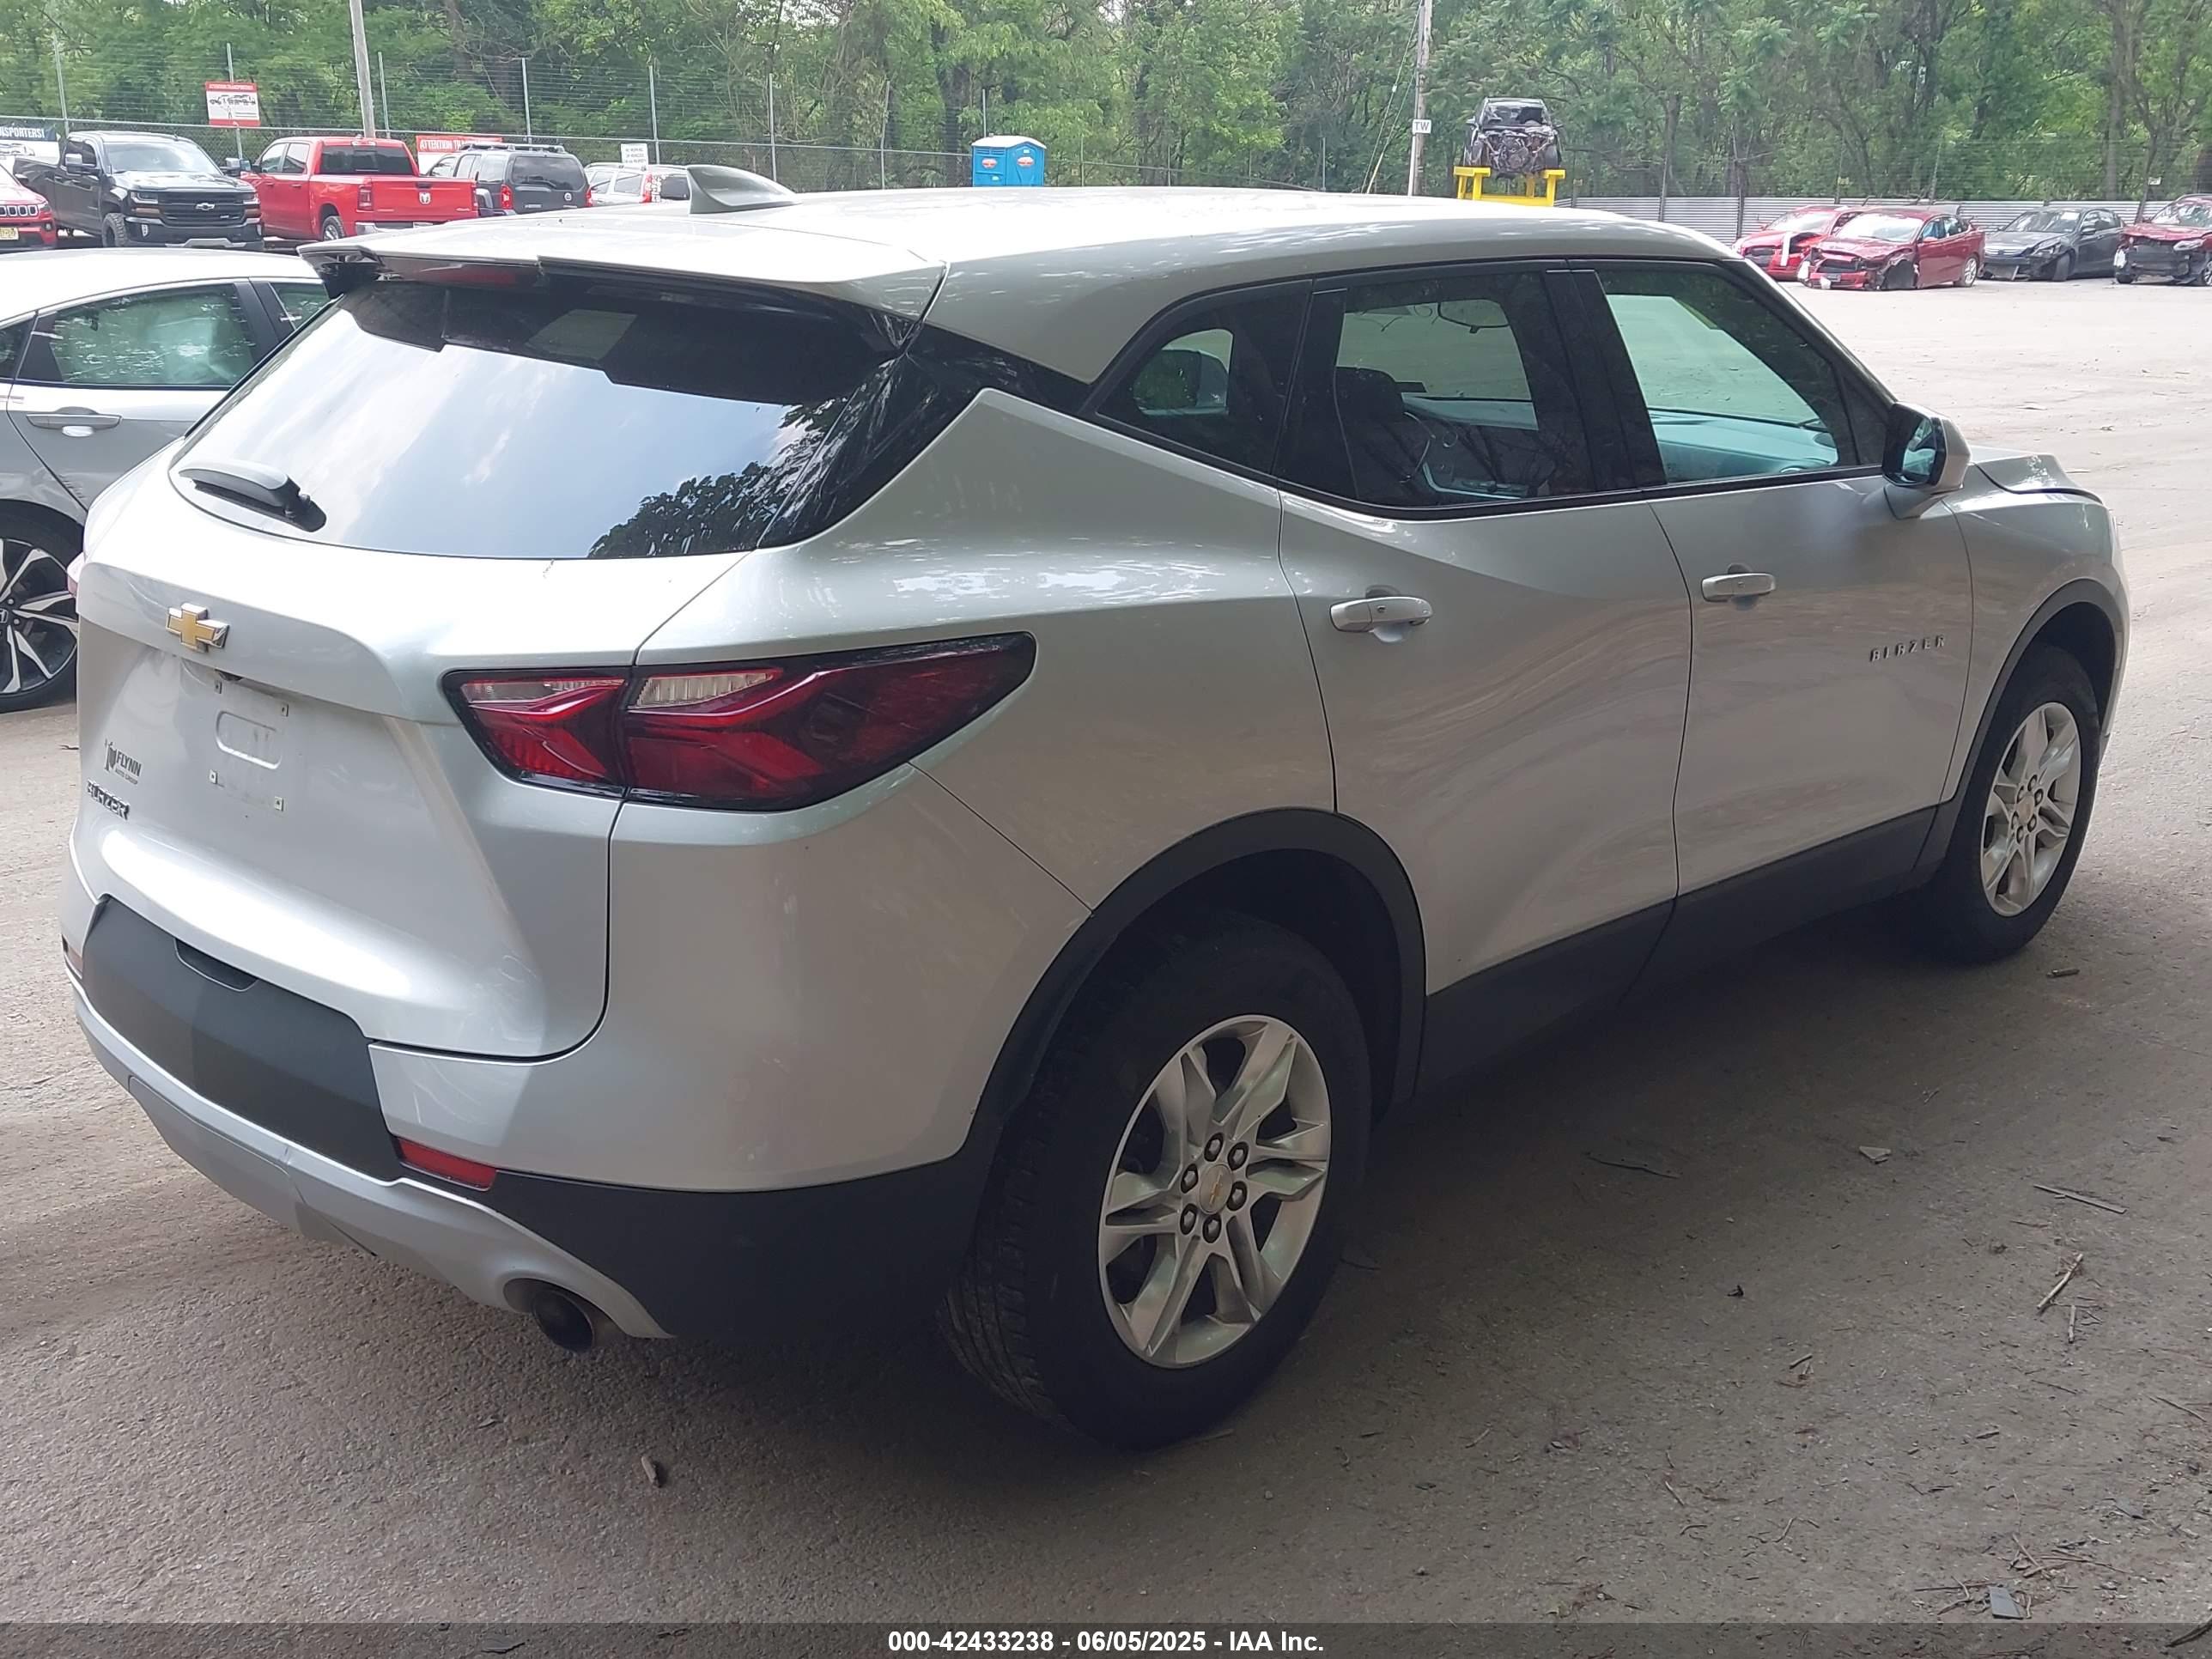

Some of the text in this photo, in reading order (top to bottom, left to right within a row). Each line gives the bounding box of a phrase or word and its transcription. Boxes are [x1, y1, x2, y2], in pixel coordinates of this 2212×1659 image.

[1413, 121, 1430, 131] TW
[1869, 635, 1945, 662] BLAZER
[117, 750, 142, 777] FLYNN
